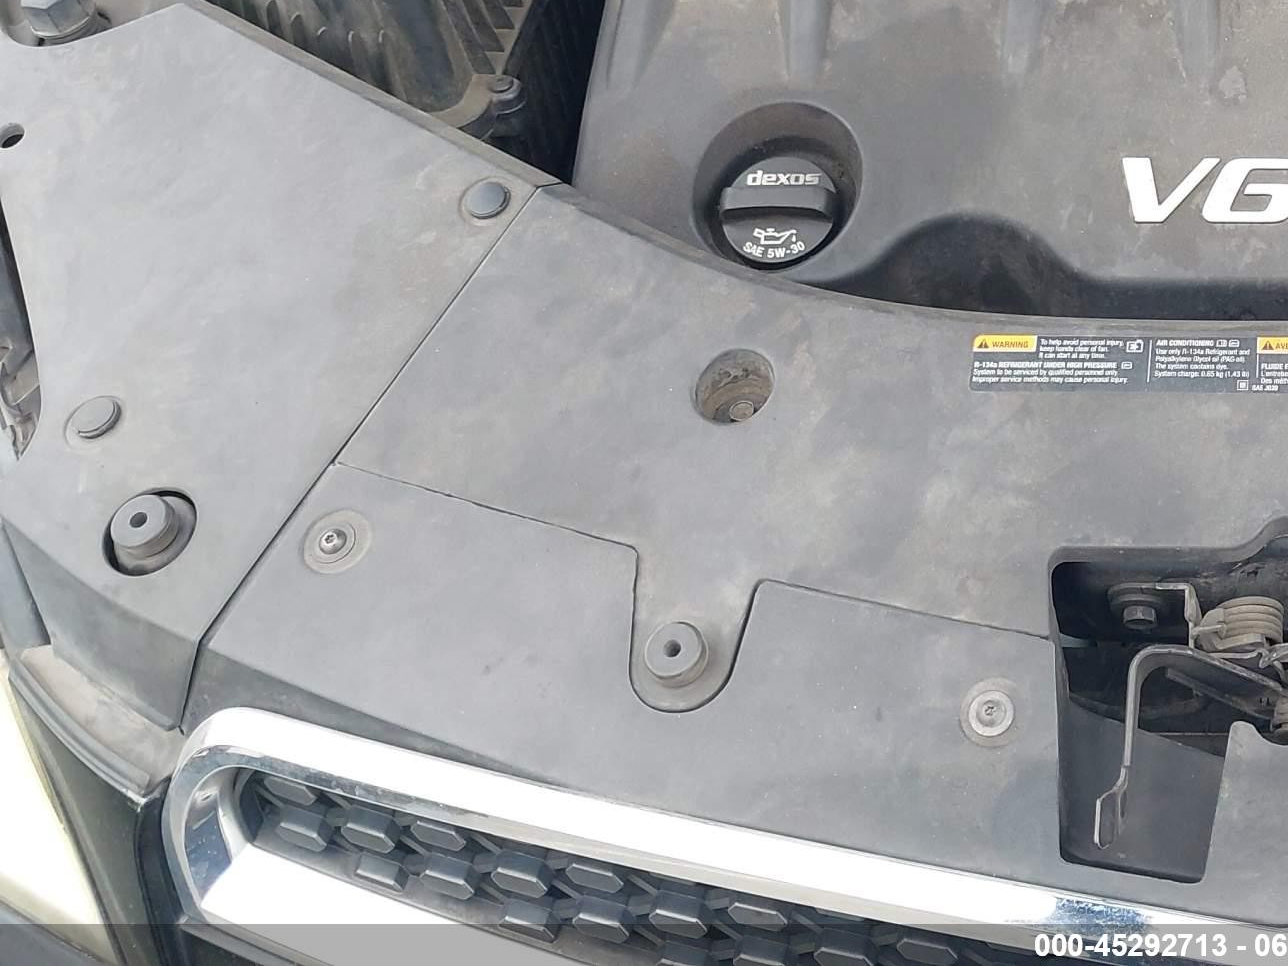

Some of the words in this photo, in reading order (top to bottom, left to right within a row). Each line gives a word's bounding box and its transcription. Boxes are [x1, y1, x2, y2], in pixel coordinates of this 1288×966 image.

[747, 170, 822, 186] dexos
[743, 241, 765, 258] SAE
[767, 241, 806, 259] 5W-30
[992, 340, 1029, 349] WARNING
[1080, 339, 1106, 347] personal
[1048, 369, 1074, 377] qualified
[1154, 370, 1177, 378] System
[972, 376, 999, 384] Improper
